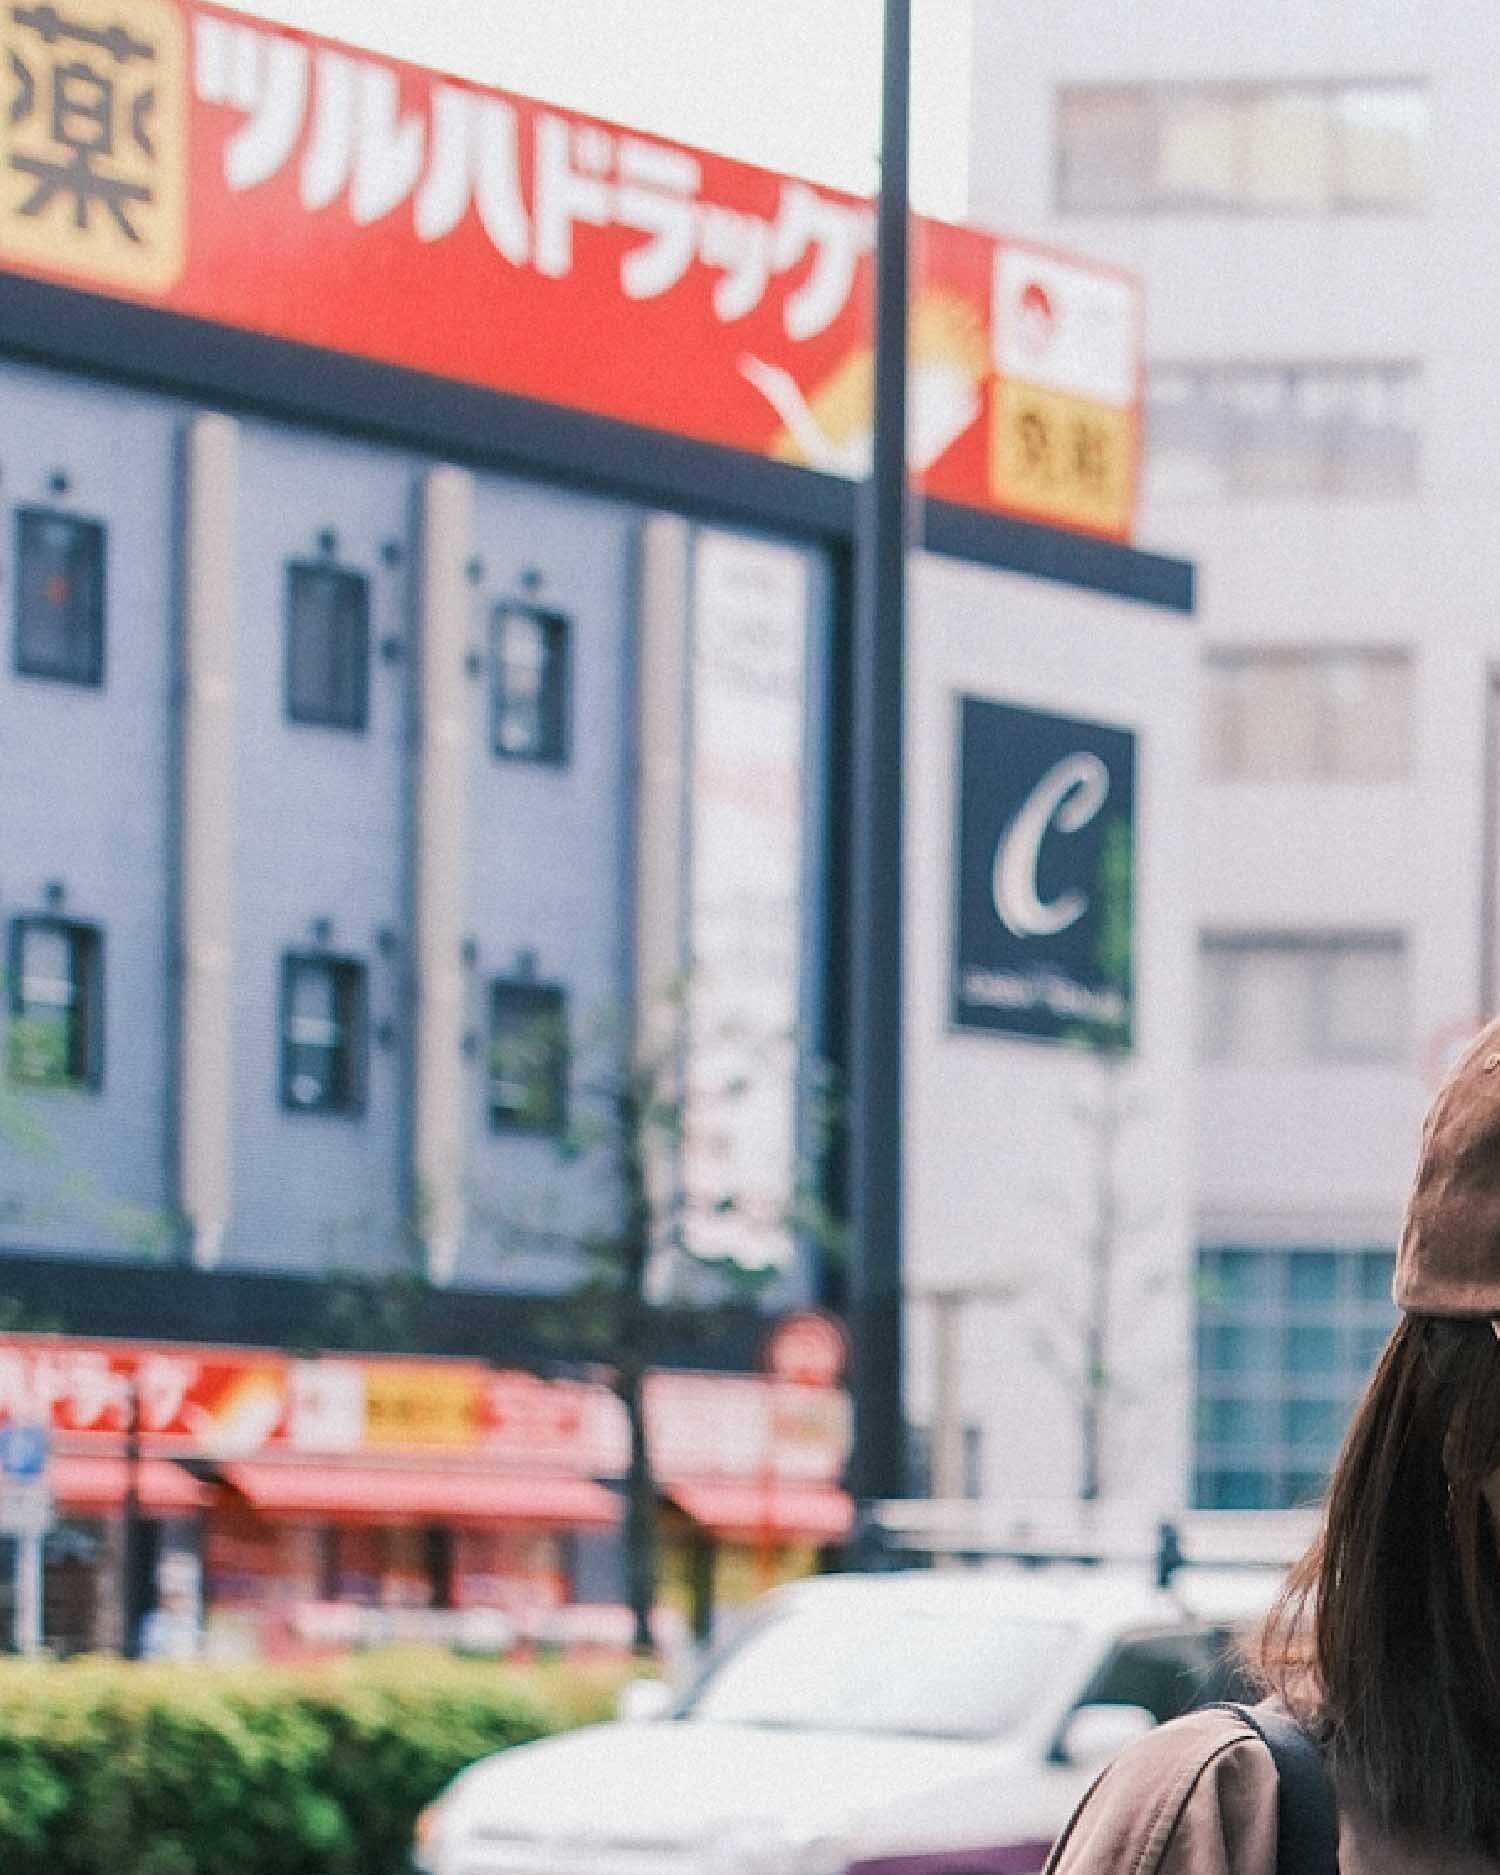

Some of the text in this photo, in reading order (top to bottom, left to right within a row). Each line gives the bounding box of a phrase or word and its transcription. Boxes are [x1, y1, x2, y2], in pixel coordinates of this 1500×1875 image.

[8, 6, 156, 243] 薬
[192, 12, 878, 343] ツルハドラッグ
[993, 751, 1109, 938] C
